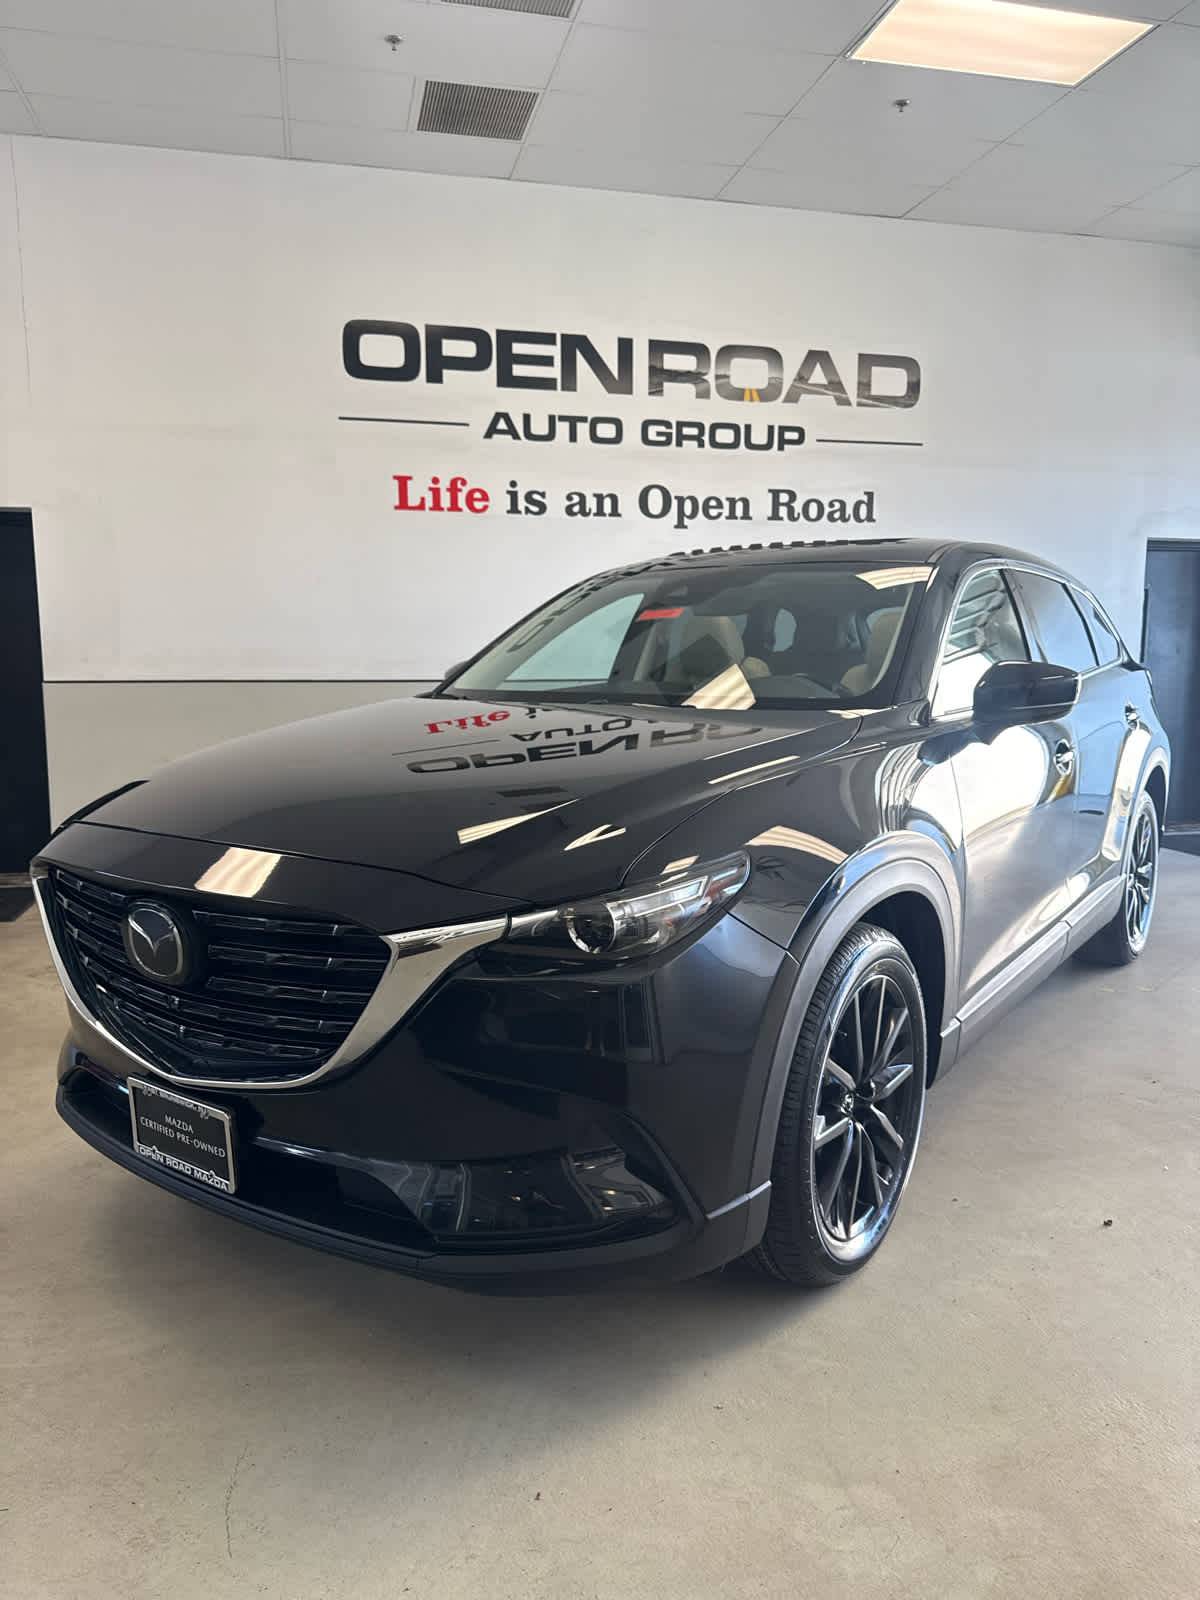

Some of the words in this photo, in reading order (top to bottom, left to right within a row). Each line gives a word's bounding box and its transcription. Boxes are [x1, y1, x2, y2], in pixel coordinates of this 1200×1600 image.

[342, 319, 634, 395] OPEN
[648, 338, 922, 409] ROAD
[483, 411, 624, 445] AUTO
[640, 418, 806, 452] GROUP
[392, 474, 491, 514] Life
[506, 480, 548, 516] is
[564, 491, 623, 518] an
[638, 484, 753, 529] Open
[767, 488, 877, 524] Road
[140, 1116, 175, 1138] CERTIFIED
[176, 1131, 226, 1158] PRE-OWNED
[164, 1114, 194, 1134] MAZDA
[139, 1147, 164, 1164] OPEN
[166, 1157, 192, 1175] ROAD
[193, 1170, 228, 1191] MAZDA
